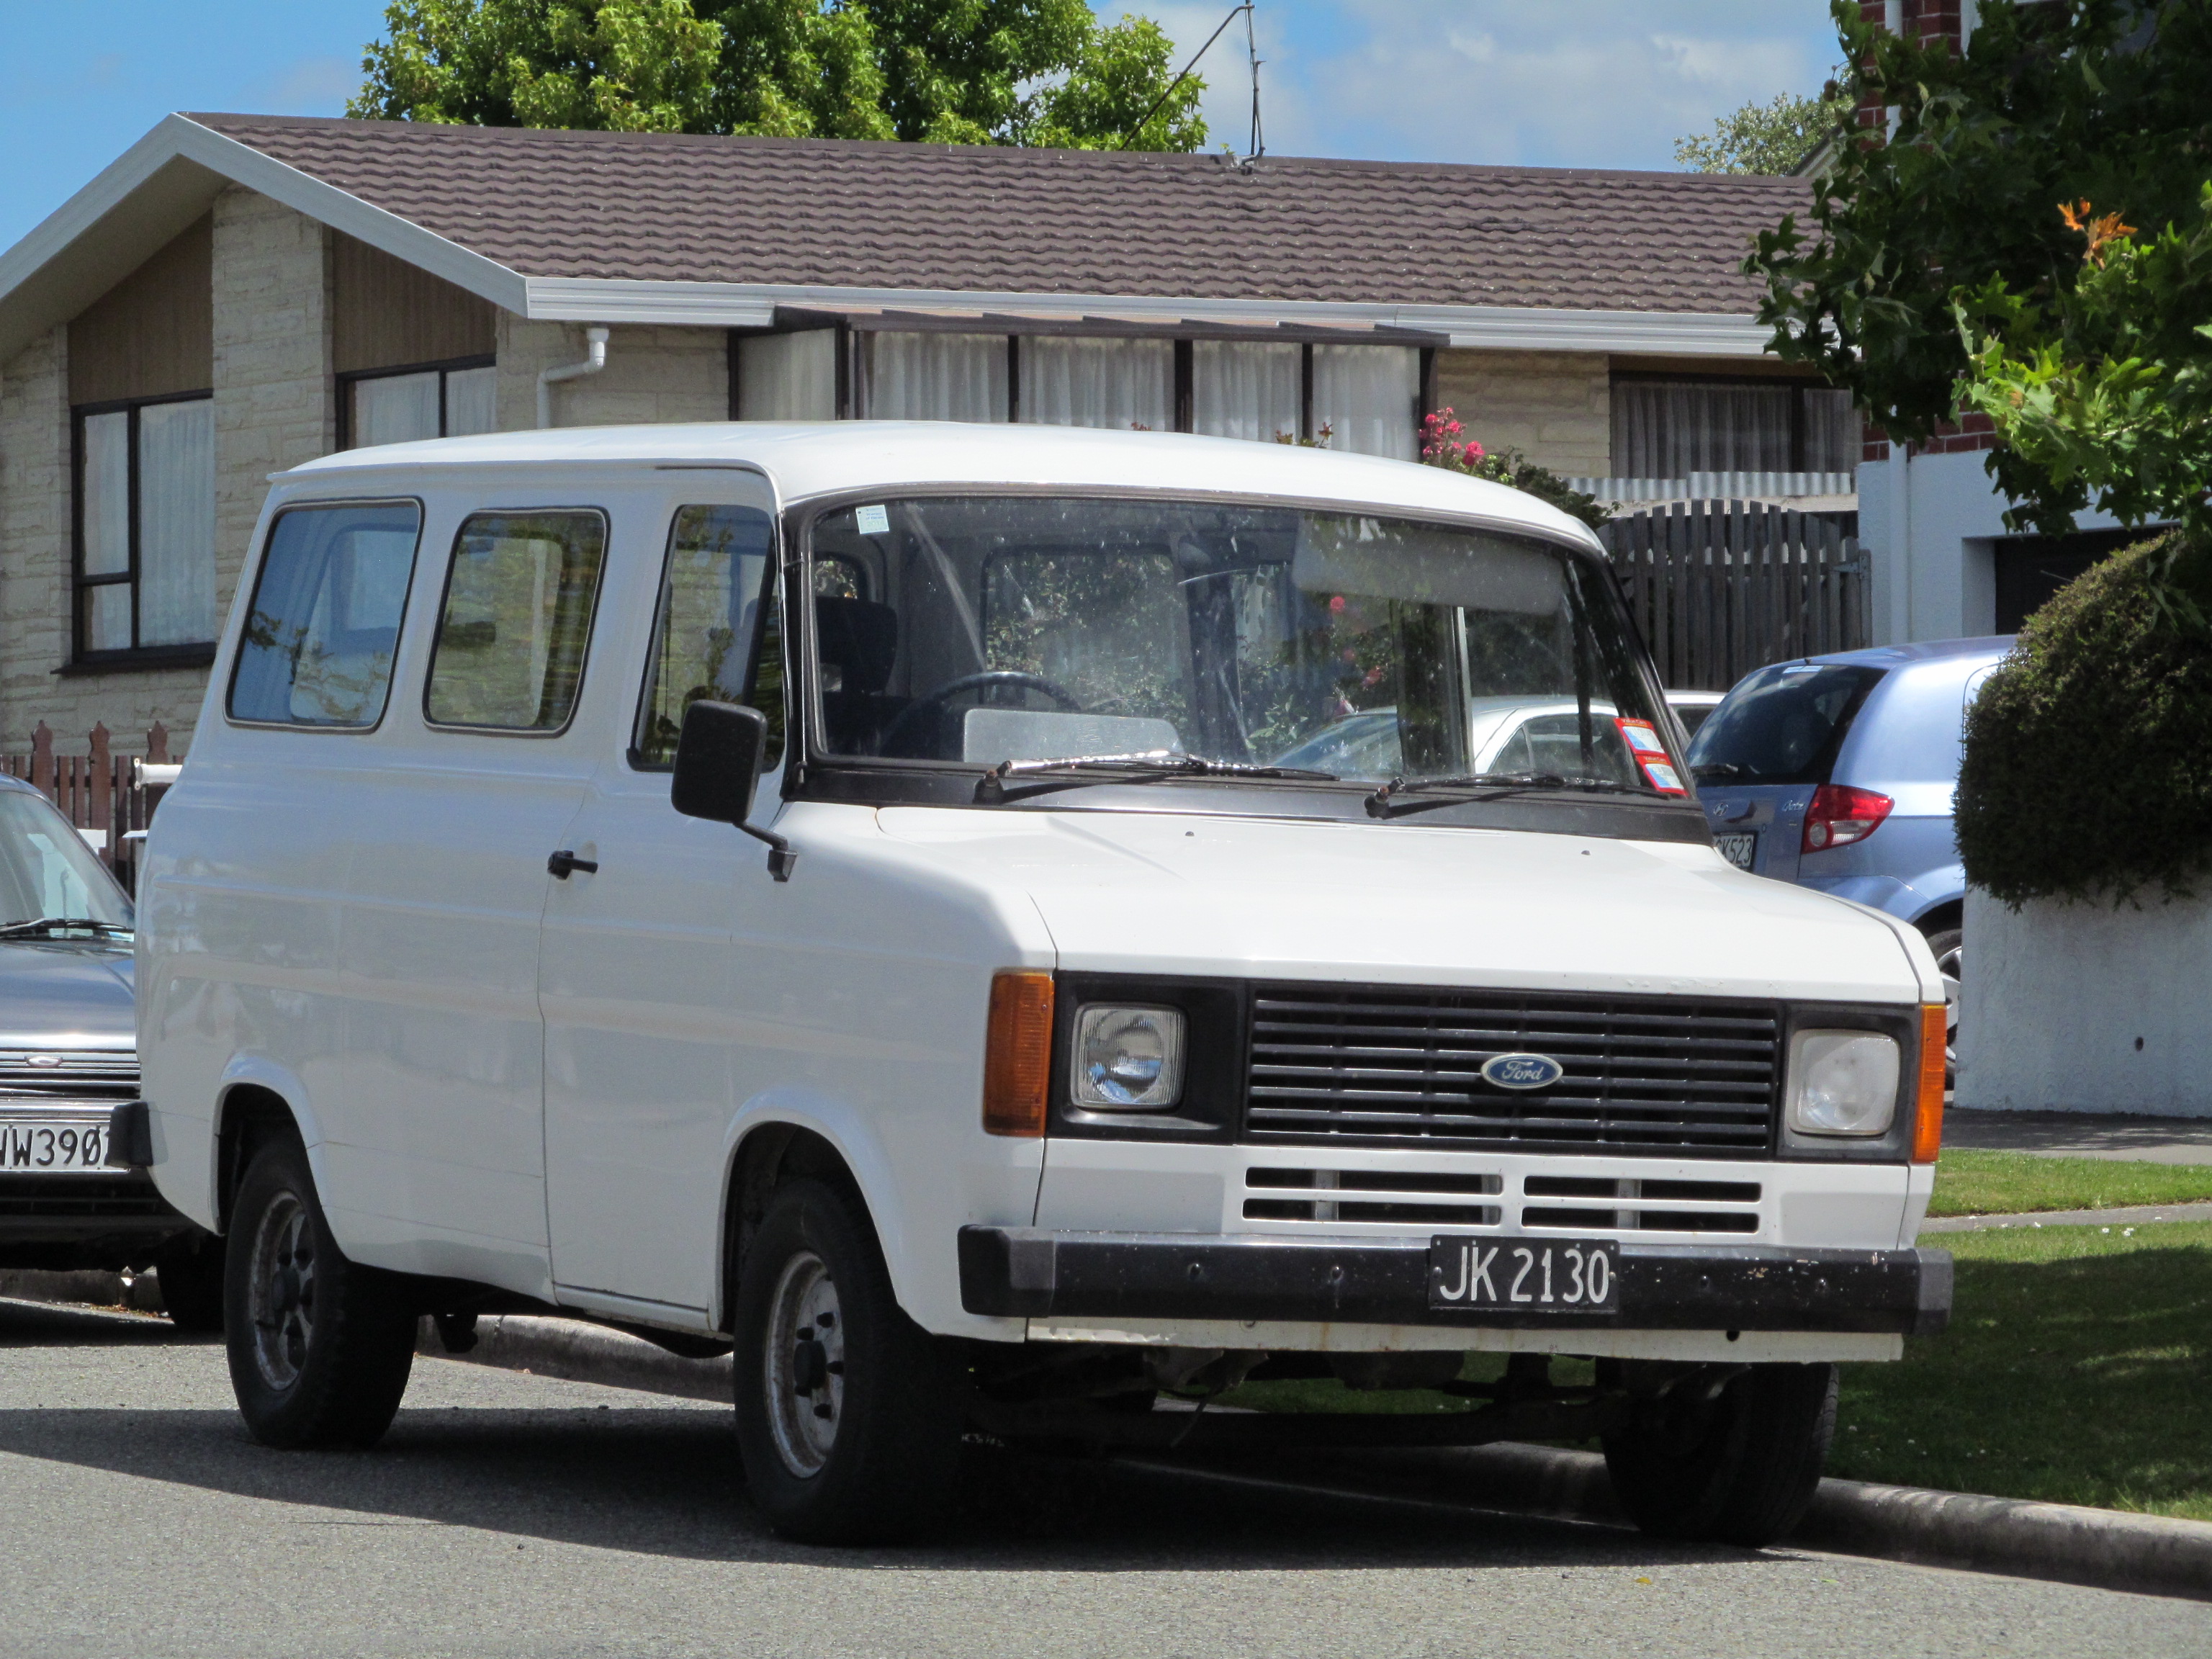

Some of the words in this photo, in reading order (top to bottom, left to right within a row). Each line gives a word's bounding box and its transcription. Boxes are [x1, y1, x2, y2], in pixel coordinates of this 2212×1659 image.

[1501, 1060, 1544, 1080] Ford
[1439, 1246, 1498, 1302] JK
[1510, 1247, 1609, 1303] 2130
